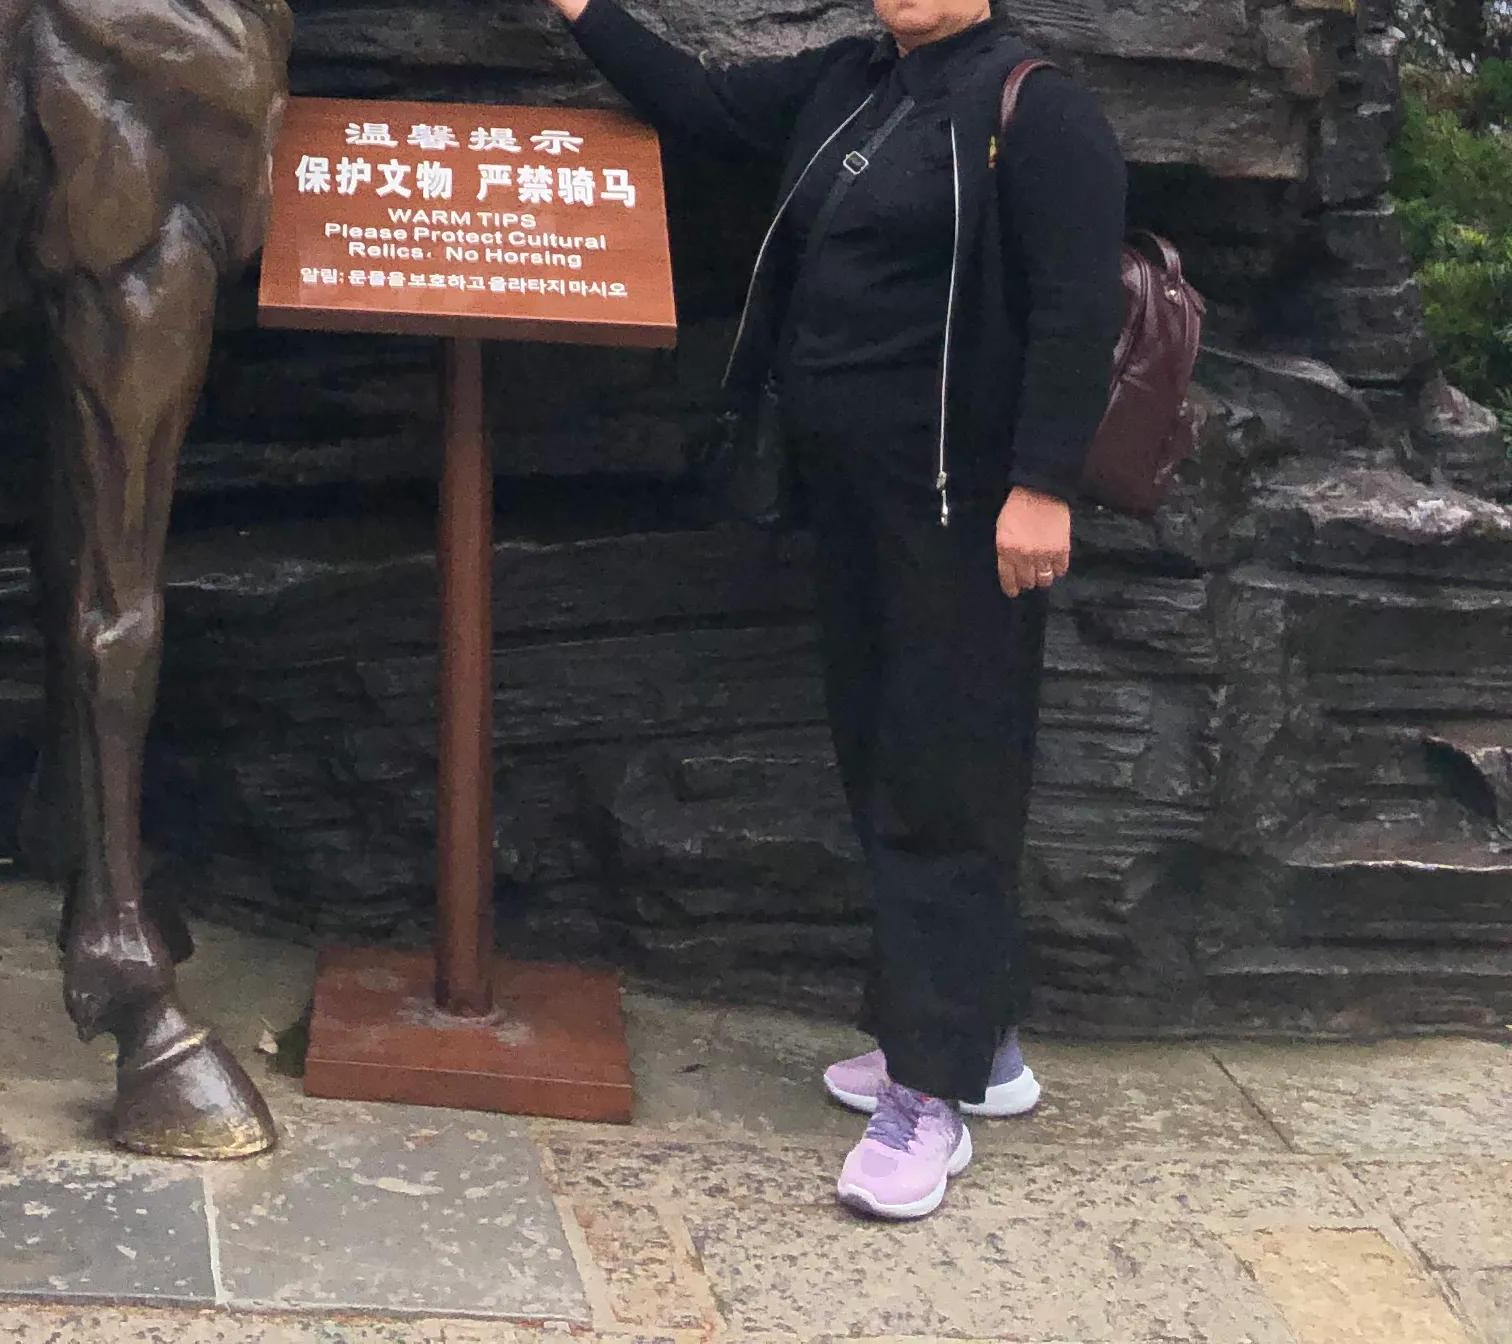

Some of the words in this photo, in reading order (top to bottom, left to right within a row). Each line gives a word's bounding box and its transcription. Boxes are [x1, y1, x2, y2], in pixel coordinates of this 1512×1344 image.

[344, 122, 584, 156] 温馨提示
[294, 154, 454, 200] 保护文物
[476, 162, 636, 208] 严禁骑马
[388, 207, 471, 226] WARM
[476, 211, 537, 229] TIPS
[324, 222, 408, 241] Please
[413, 226, 503, 246] Protect
[508, 230, 607, 251] Cultural
[445, 246, 479, 263] No
[485, 248, 583, 270] Horsing
